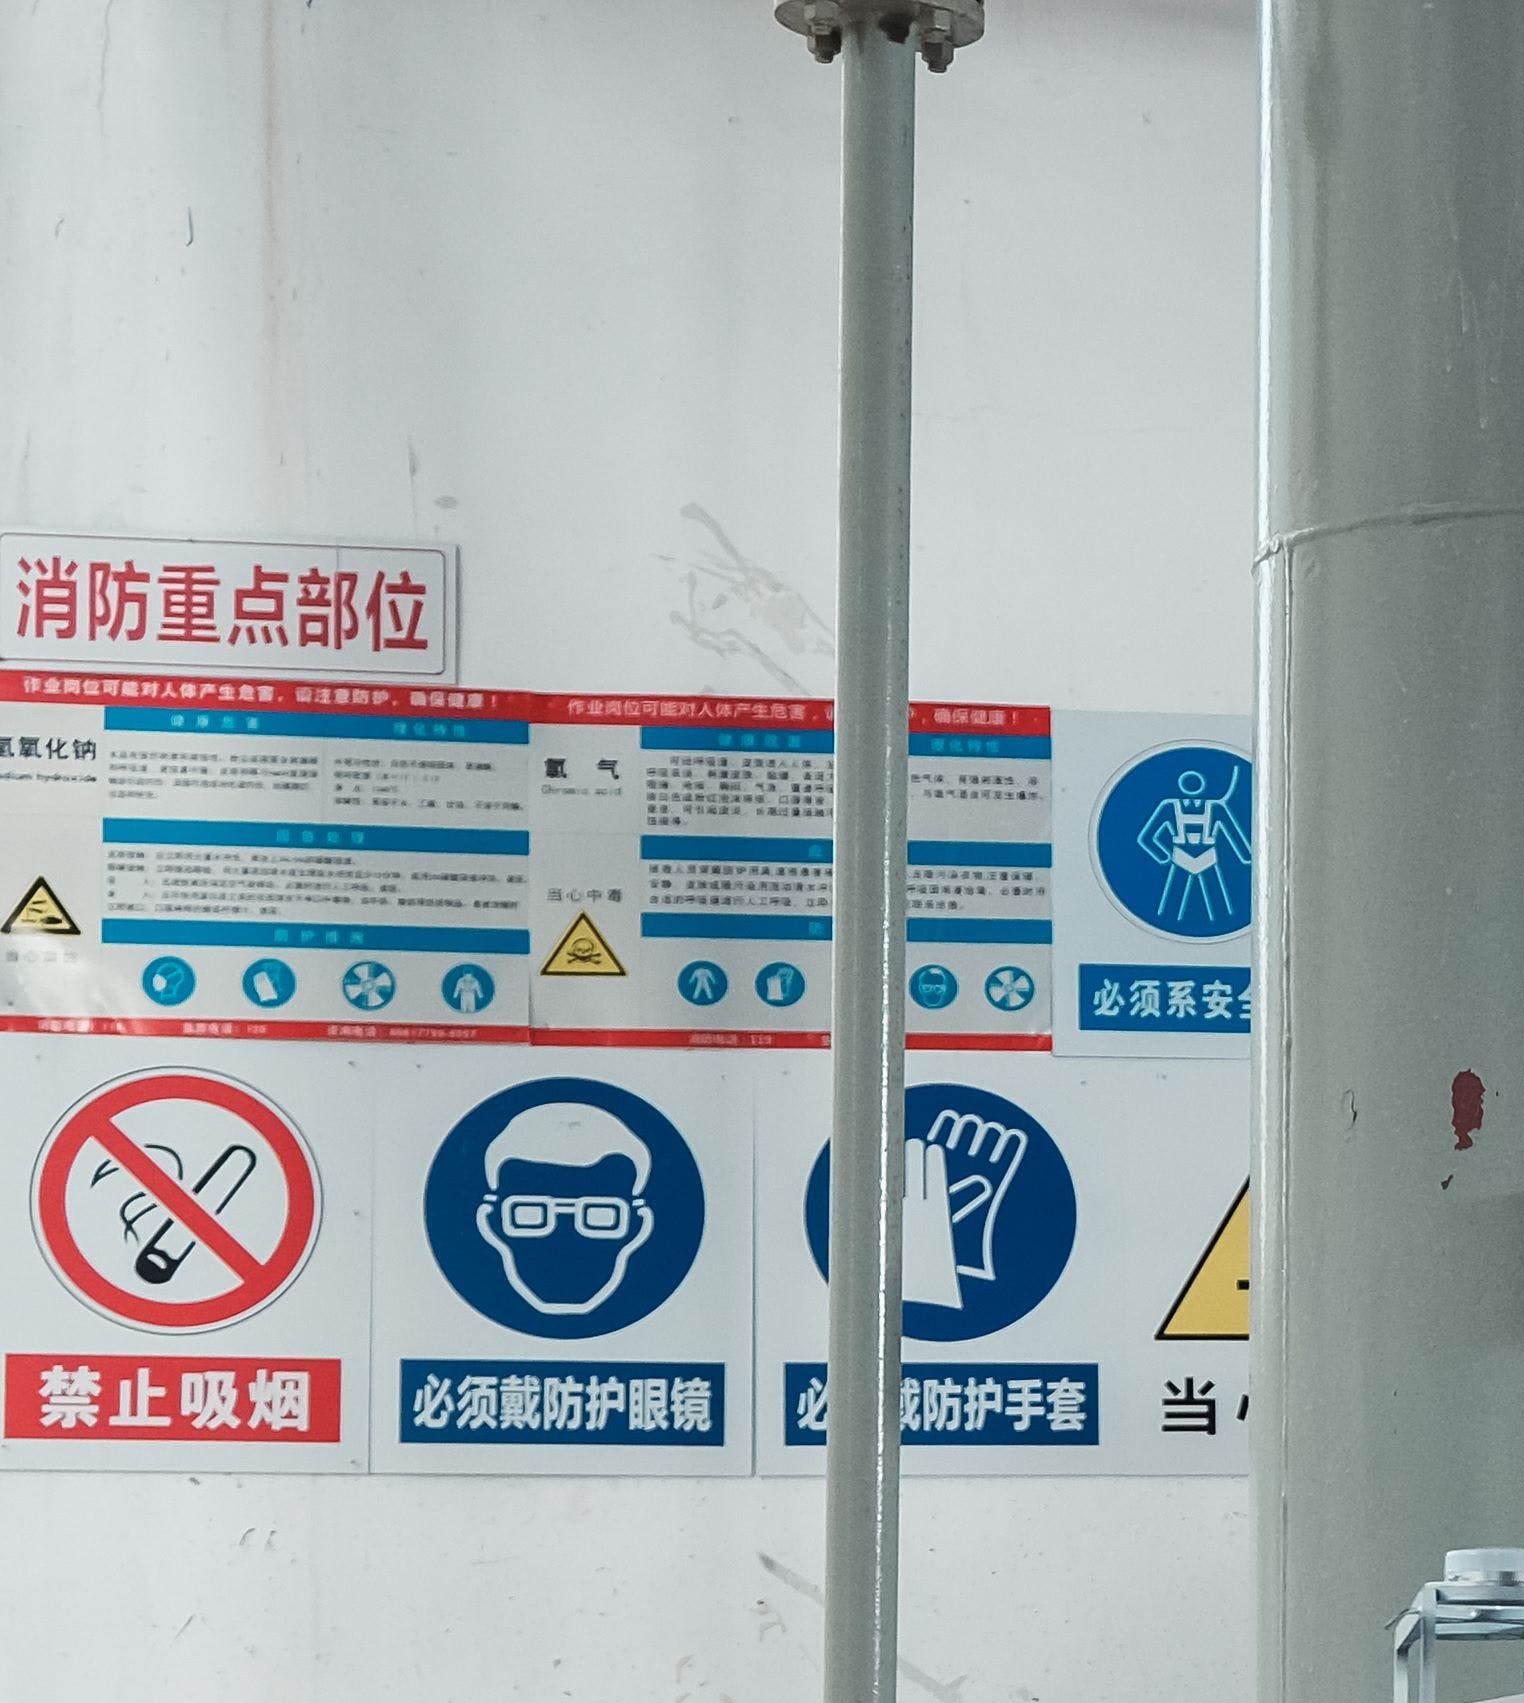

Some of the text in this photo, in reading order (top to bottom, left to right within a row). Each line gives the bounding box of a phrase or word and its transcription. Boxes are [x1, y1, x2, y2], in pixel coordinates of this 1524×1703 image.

[15, 554, 429, 653] 消防重点部位
[547, 887, 624, 904] 当心中毒
[39, 1363, 312, 1432] 禁止吸烟
[412, 1373, 713, 1433] 必须戴防护眼镜
[1161, 1376, 1250, 1435] 当
